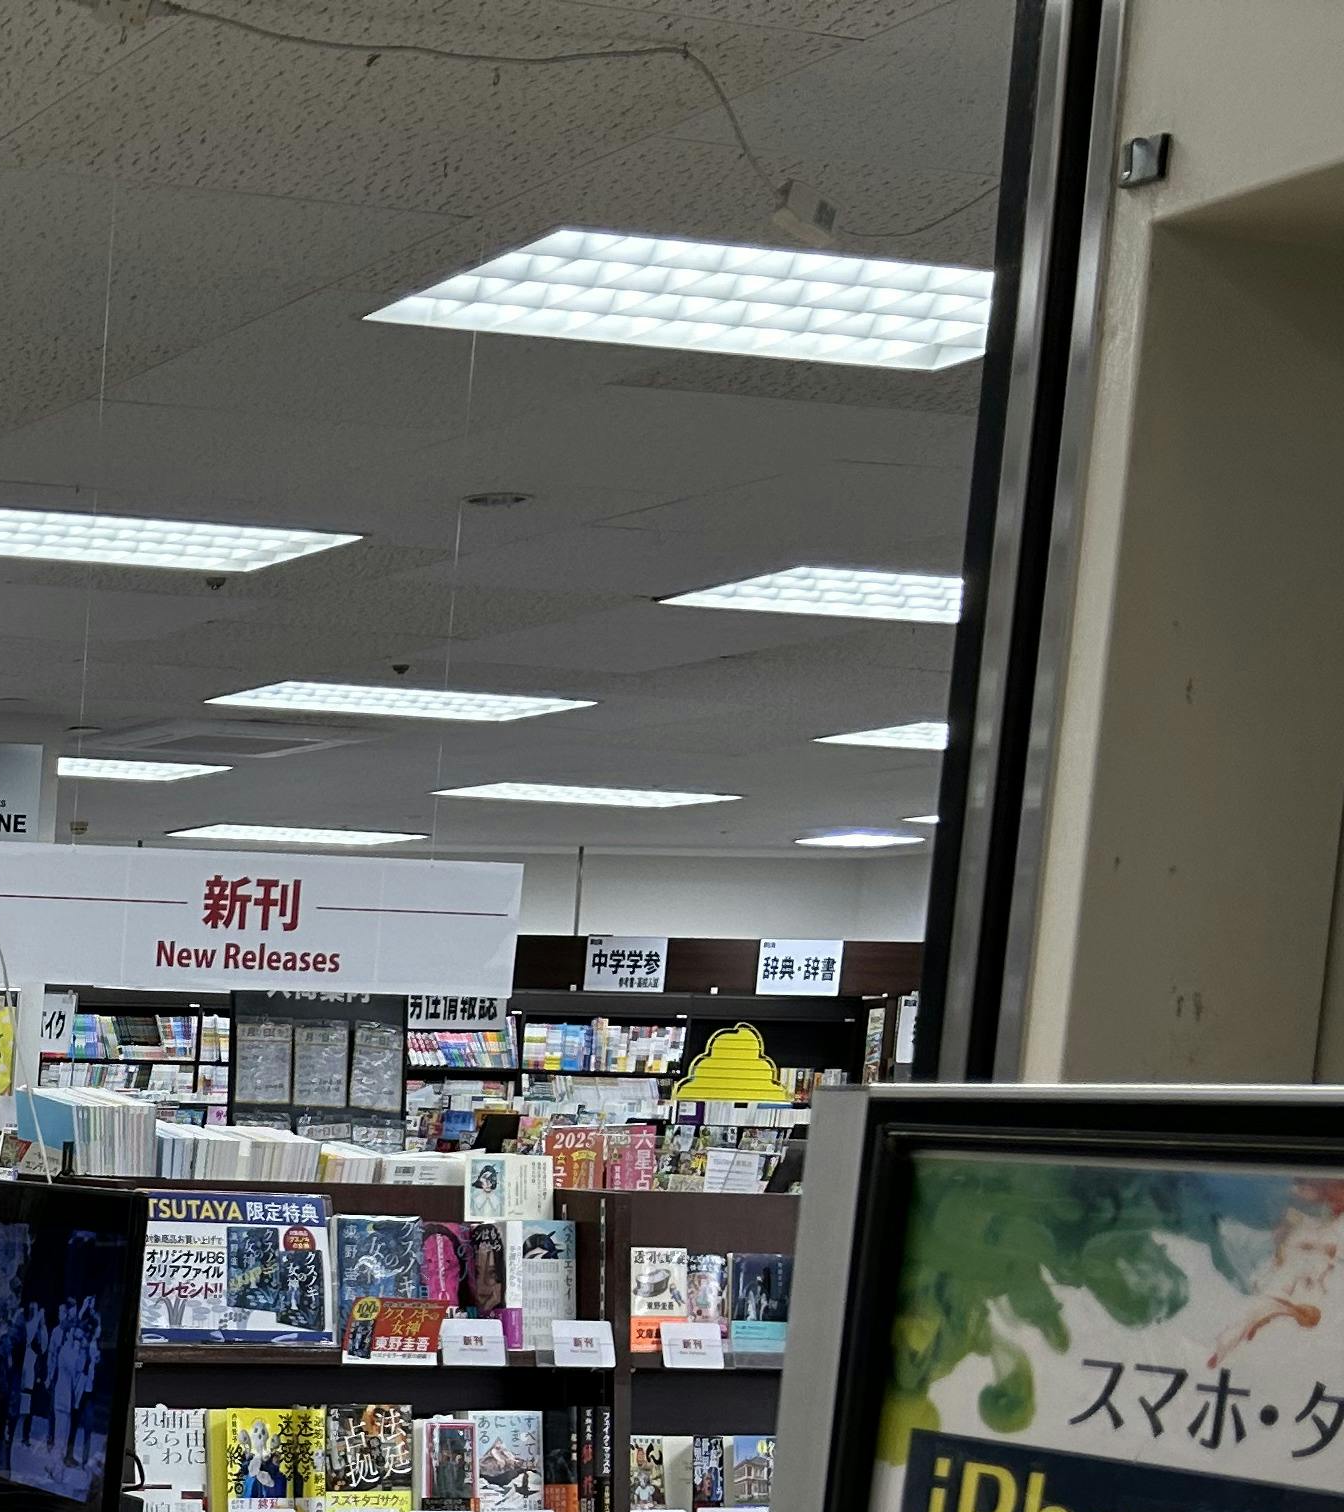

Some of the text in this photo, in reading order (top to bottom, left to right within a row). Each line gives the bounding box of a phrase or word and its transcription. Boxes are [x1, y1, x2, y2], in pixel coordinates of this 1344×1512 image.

[202, 876, 301, 931] 新刊
[156, 940, 341, 973] New Releases
[592, 949, 661, 975] 中学学参
[763, 956, 836, 981] 辞典・辞書
[552, 1132, 596, 1149] 2025
[147, 1199, 320, 1223] TSUTAYA 限定特典
[146, 1251, 225, 1264] オリジナルB6
[146, 1265, 224, 1279] クリアファイル
[146, 1282, 223, 1298] プレゼント!!
[1069, 1356, 1344, 1459] スマホ・タ
[344, 1418, 379, 1487] 占拠
[376, 1409, 412, 1477] 法廷
